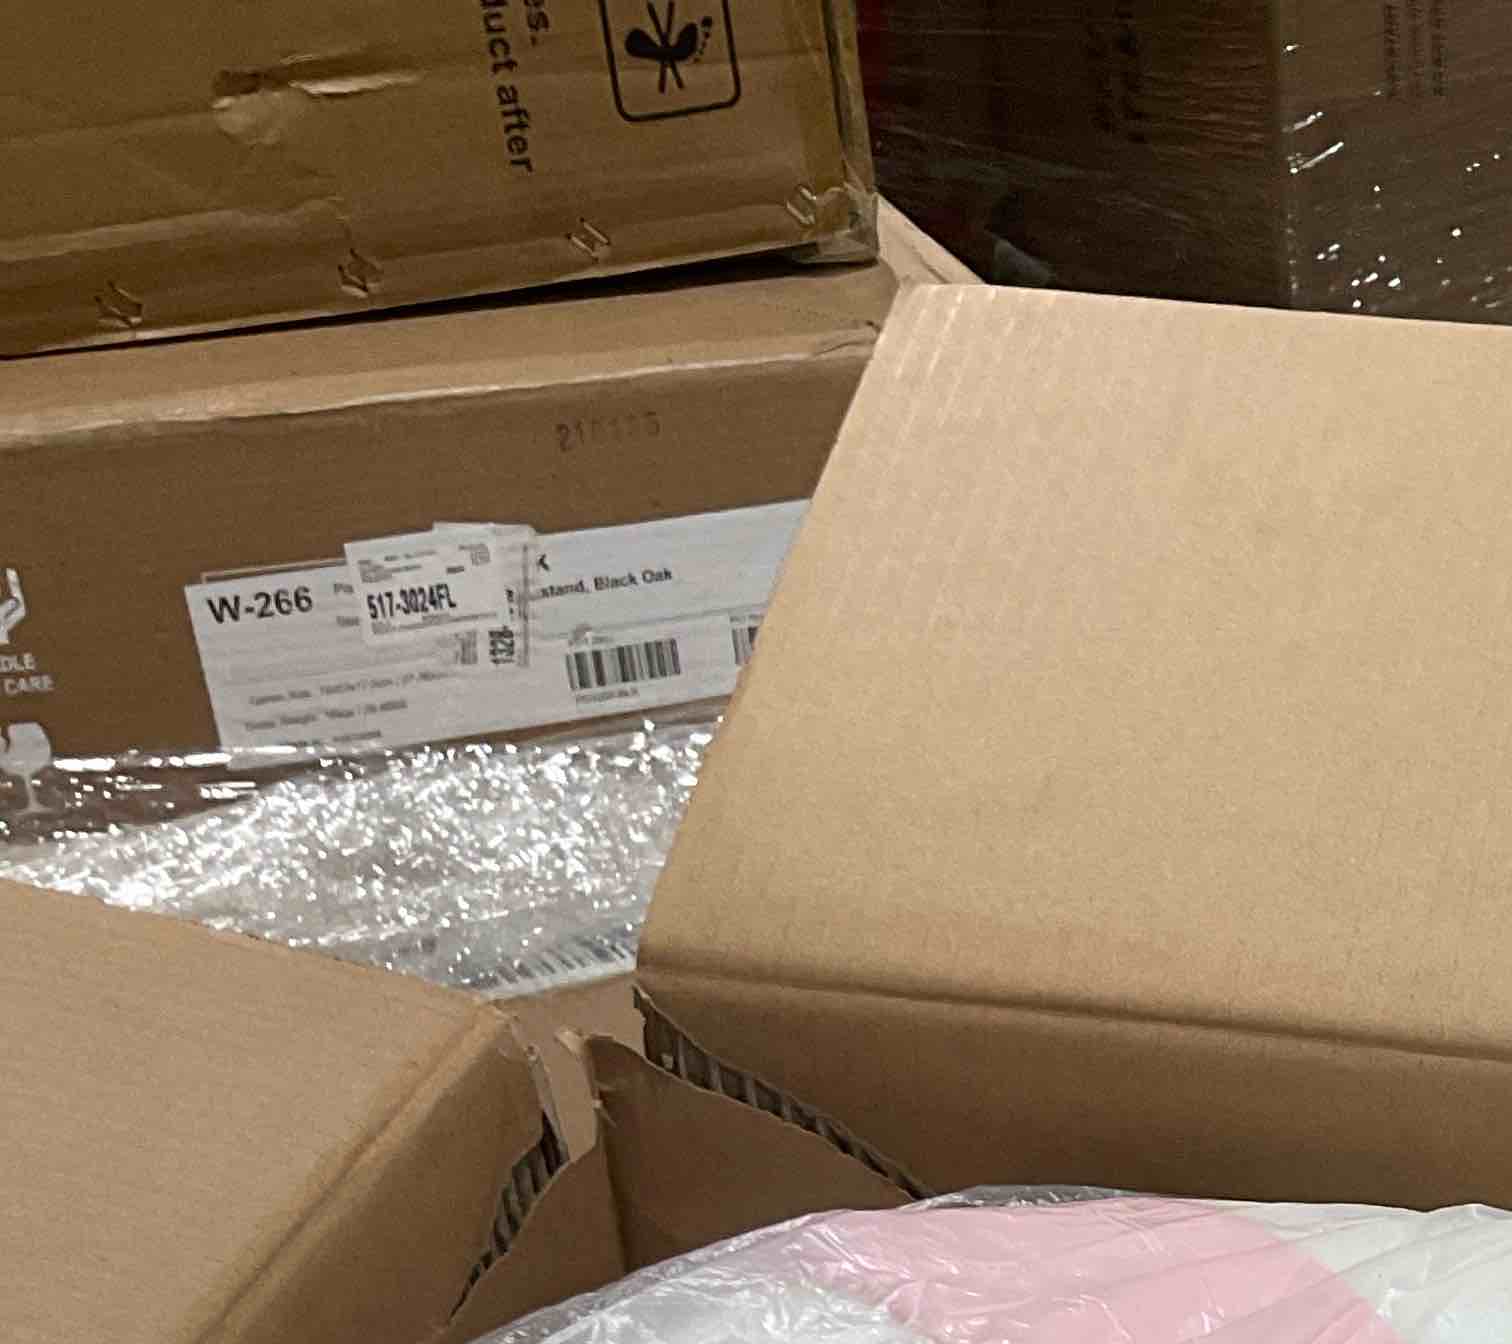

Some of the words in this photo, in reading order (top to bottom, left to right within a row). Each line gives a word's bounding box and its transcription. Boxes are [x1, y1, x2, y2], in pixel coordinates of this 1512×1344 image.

[496, 85, 534, 174] after
[593, 572, 638, 591] Black
[641, 567, 673, 584] Oak
[206, 586, 313, 624] W-266
[366, 583, 457, 620] 517-3024FL
[4, 674, 55, 695] CARE
